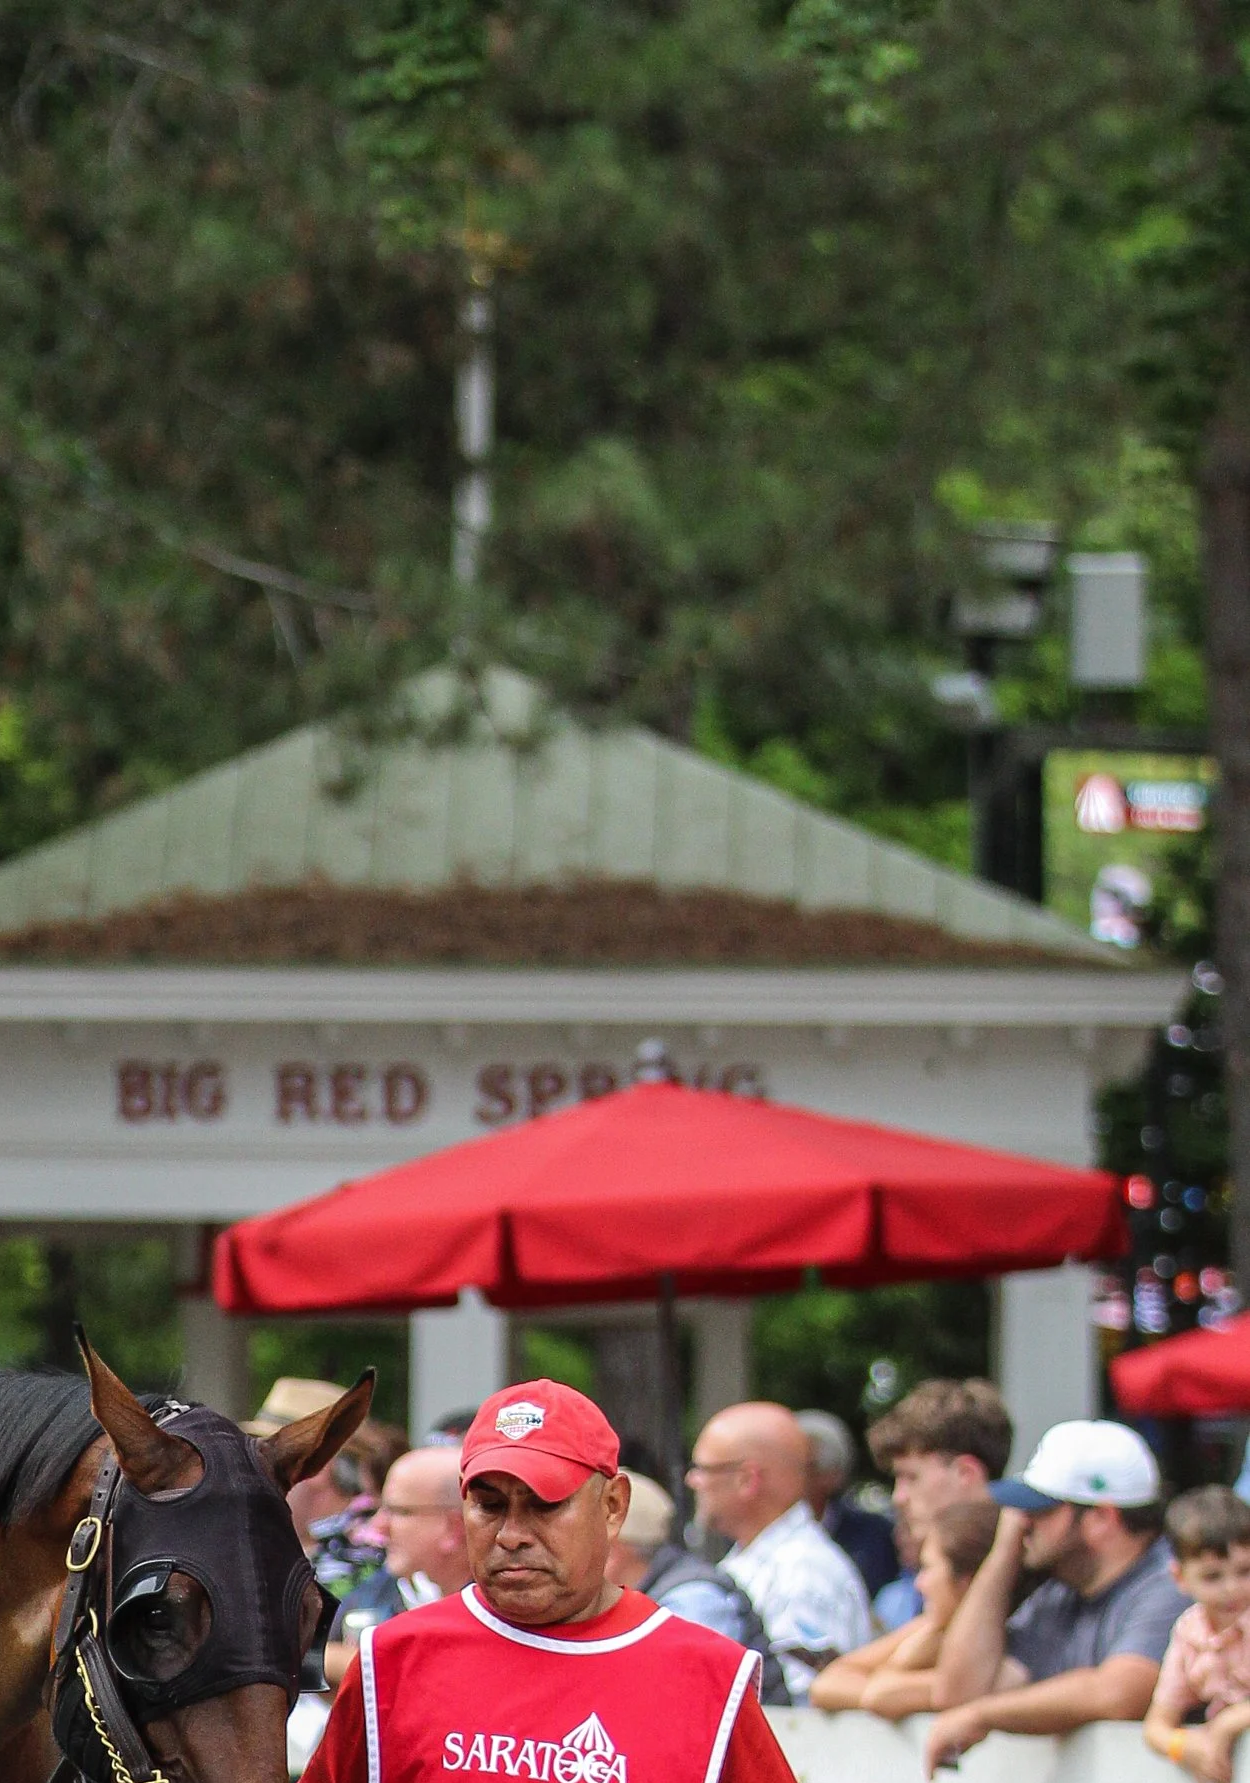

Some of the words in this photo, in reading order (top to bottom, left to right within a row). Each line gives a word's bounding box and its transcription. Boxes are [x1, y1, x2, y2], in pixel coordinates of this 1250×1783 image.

[116, 1060, 226, 1122] BIG
[275, 1062, 429, 1124] RED
[474, 1062, 765, 1124] SPRG
